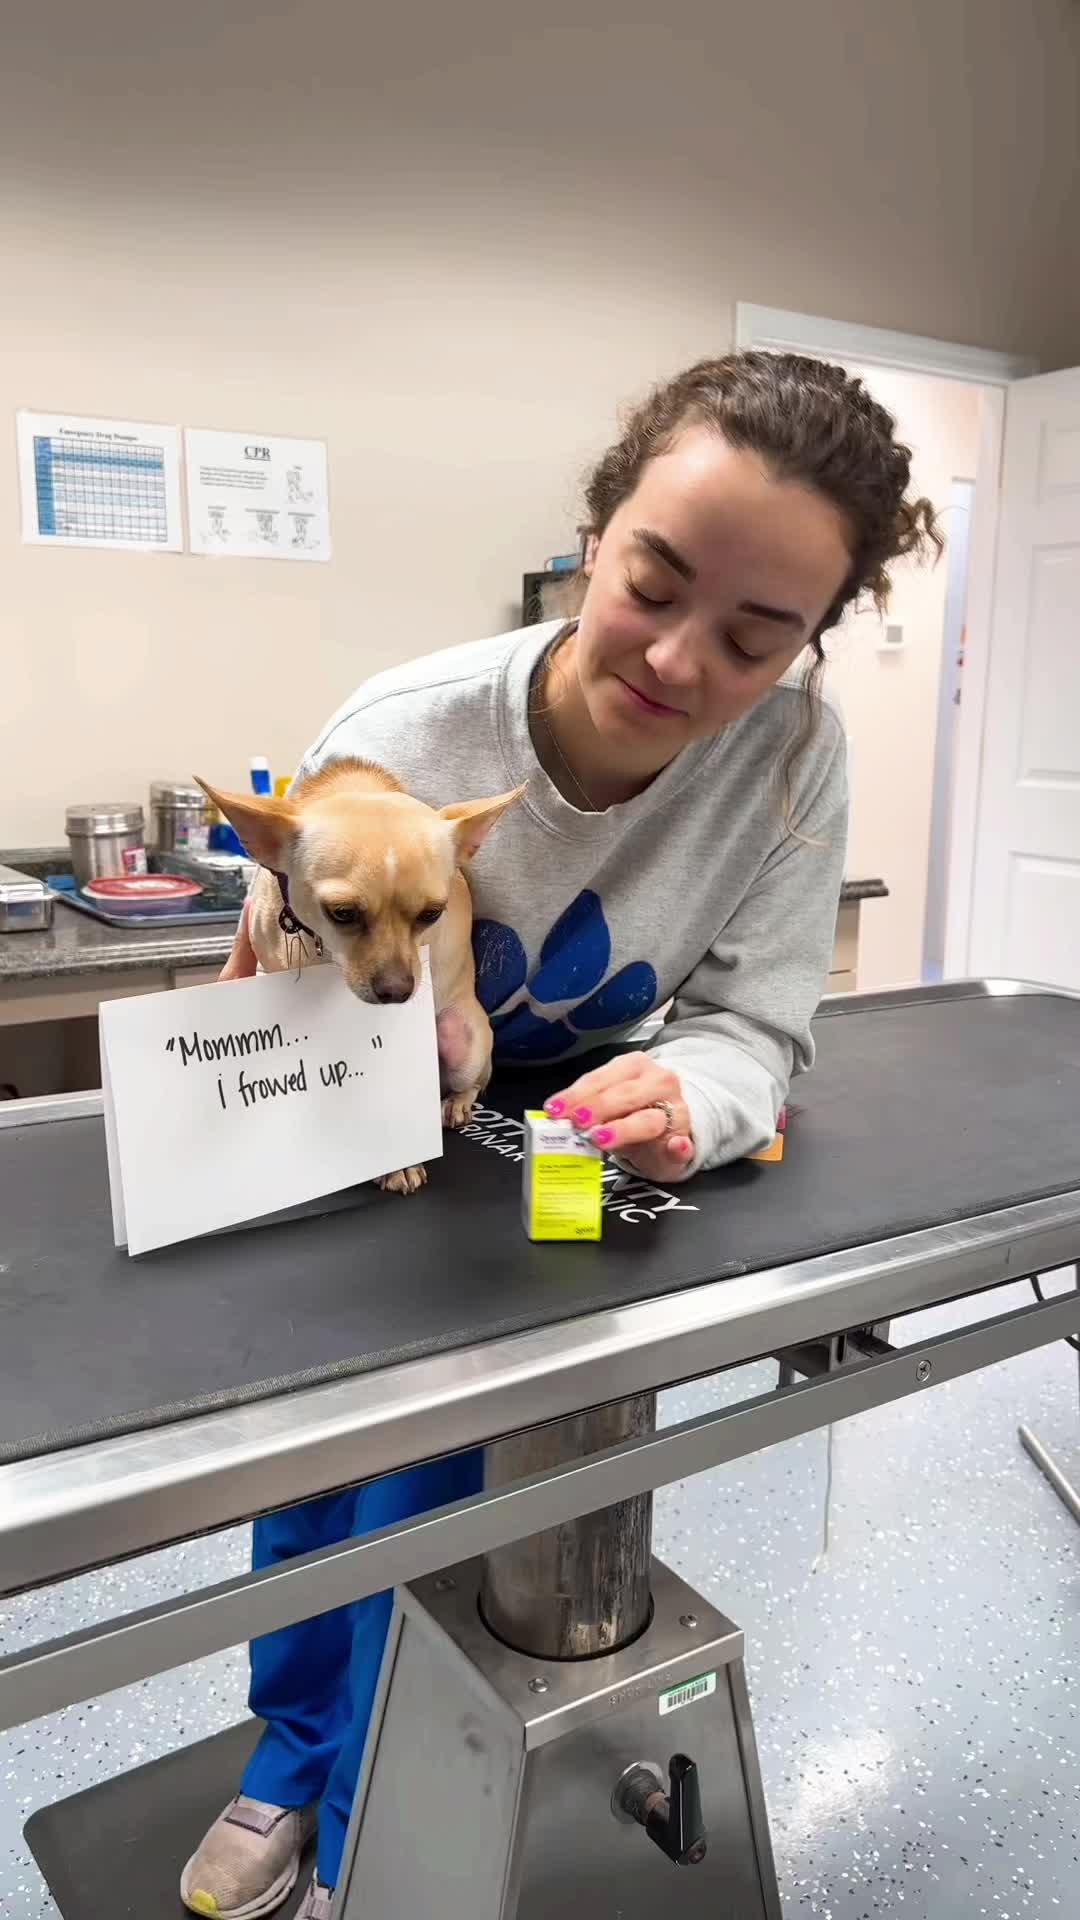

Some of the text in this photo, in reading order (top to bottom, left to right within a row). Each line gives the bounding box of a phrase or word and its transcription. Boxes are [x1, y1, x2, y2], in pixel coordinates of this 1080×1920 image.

[244, 445, 271, 461] CPR
[217, 1072, 227, 1110] i
[238, 1058, 307, 1107] frowed
[319, 1060, 364, 1087] up...
